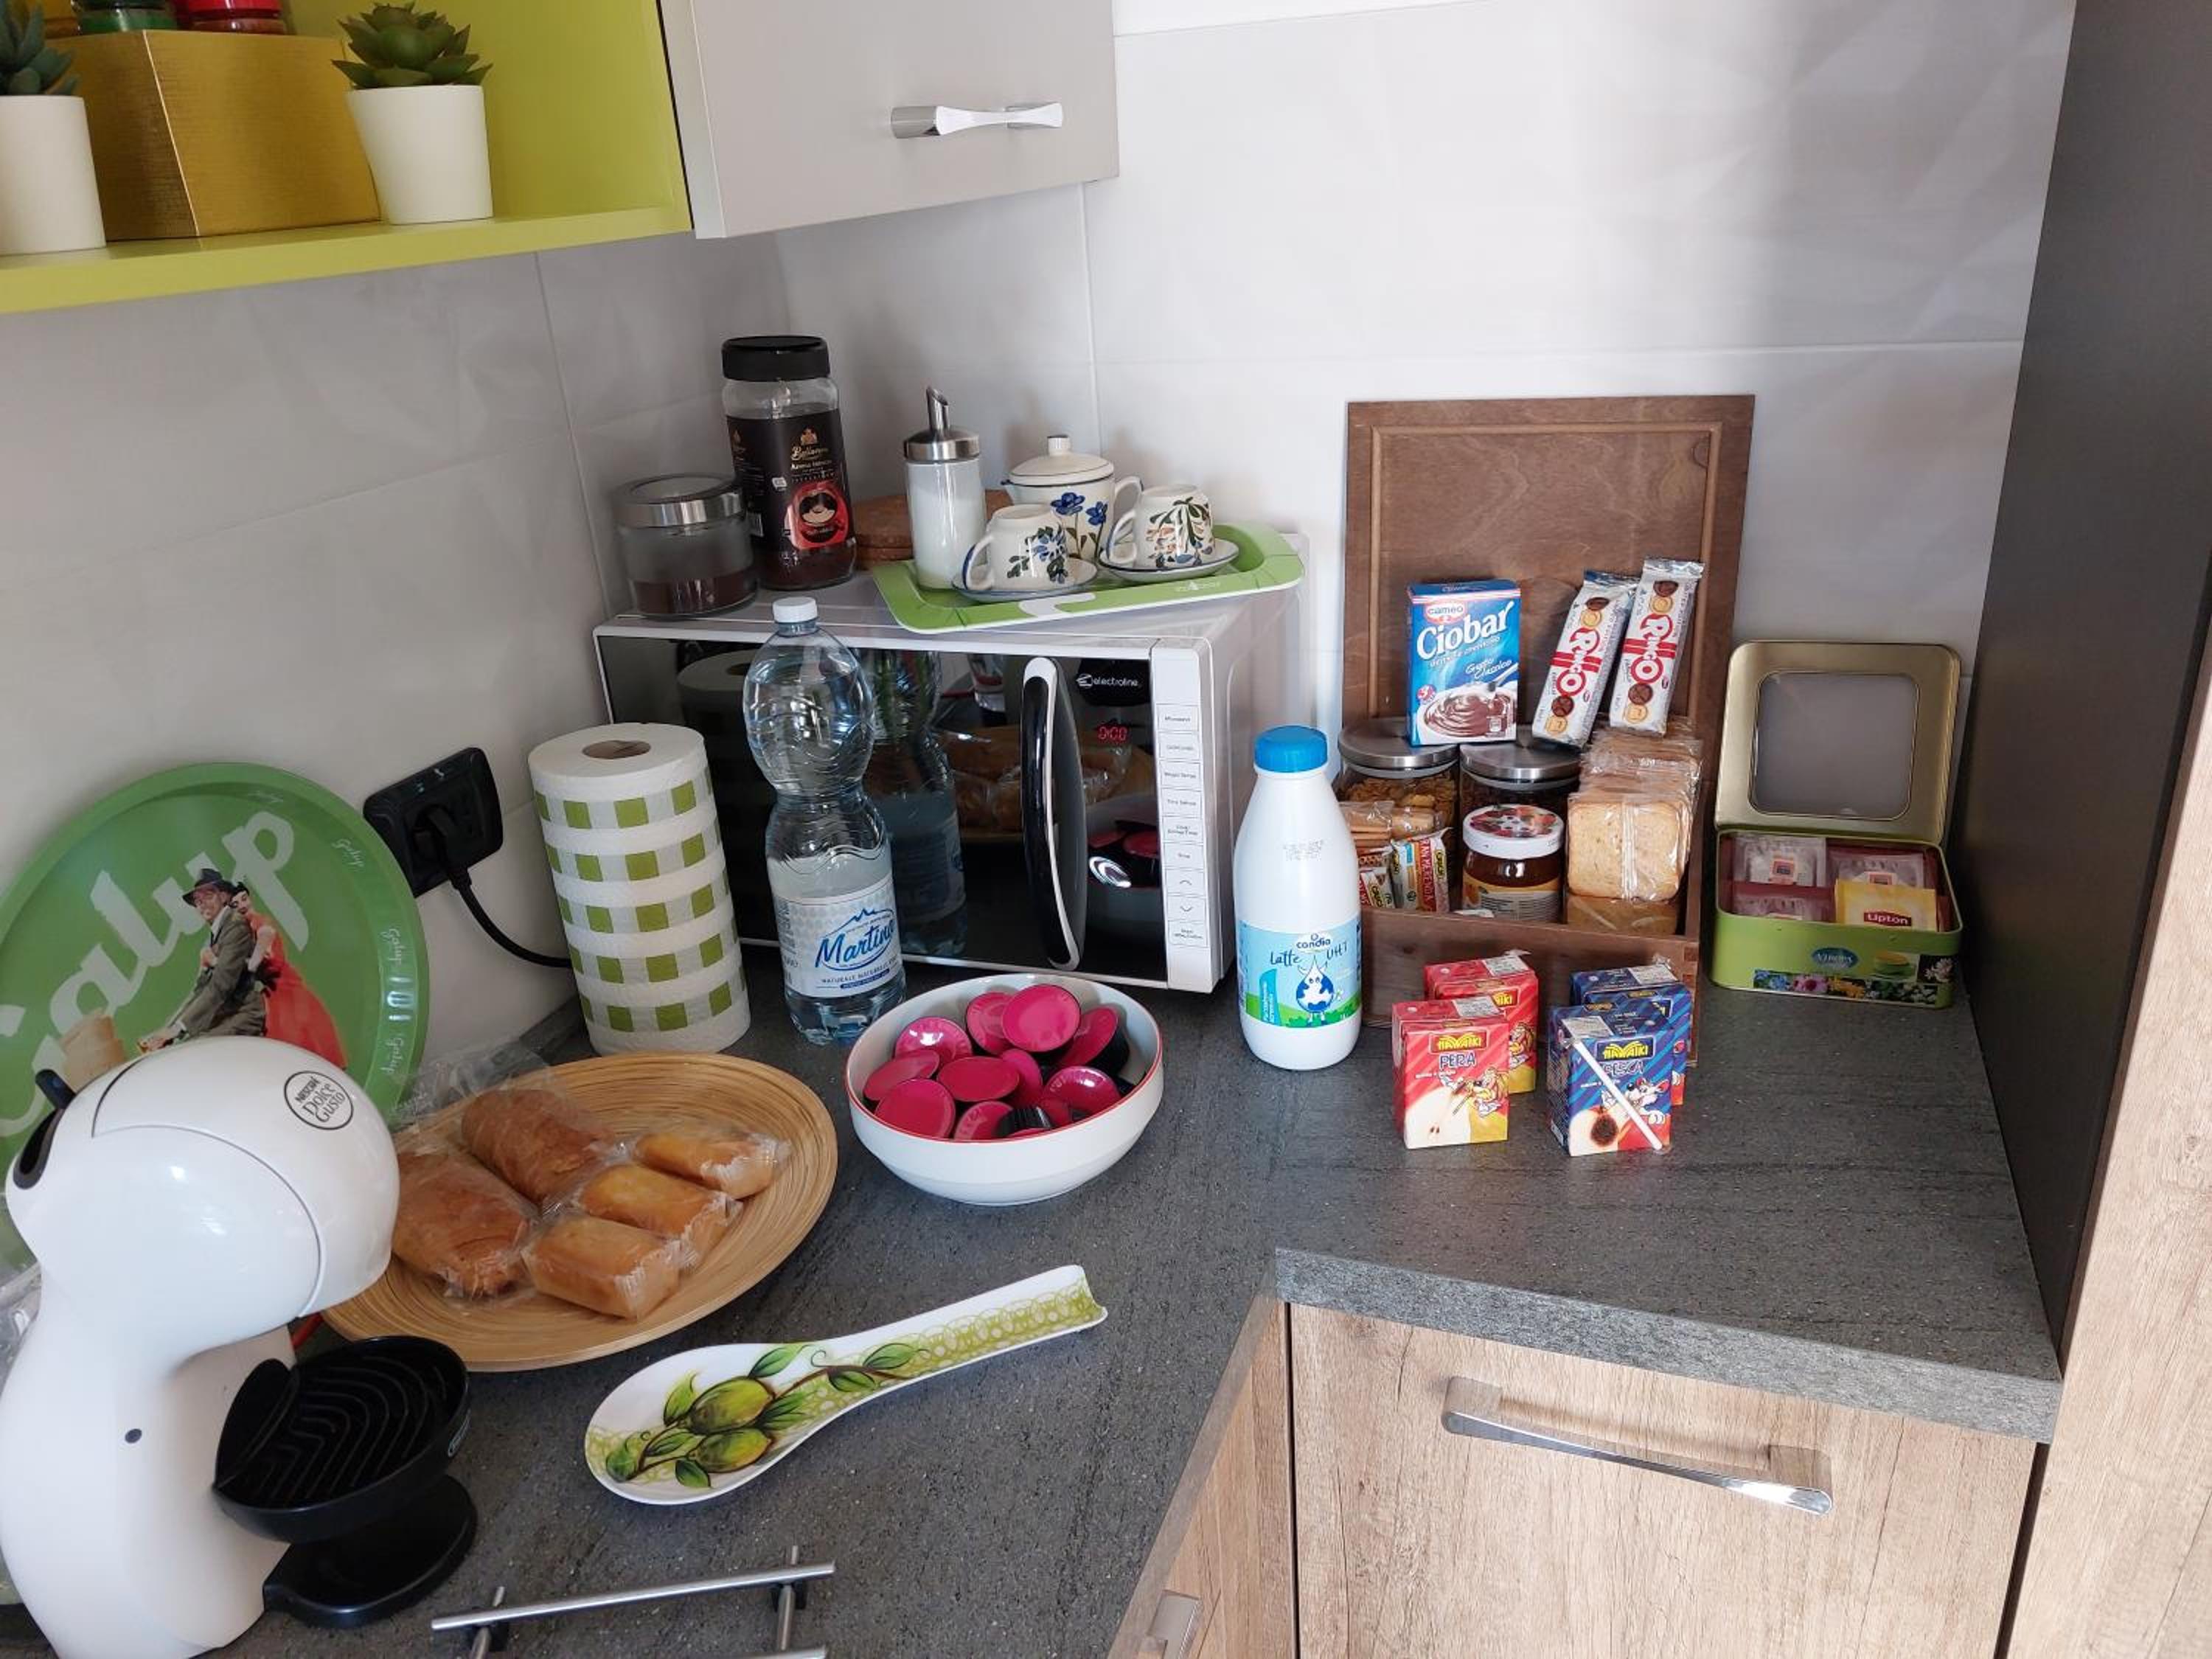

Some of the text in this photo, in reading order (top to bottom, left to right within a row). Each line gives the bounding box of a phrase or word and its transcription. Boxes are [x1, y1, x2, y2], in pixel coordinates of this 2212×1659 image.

[1427, 605, 1464, 616] cameo
[1417, 600, 1514, 661] Ciobar
[1092, 676, 1140, 687] electroline
[1867, 913, 1908, 925] Lipton
[1270, 949, 1303, 967] Latte
[1439, 1051, 1475, 1069] PERA
